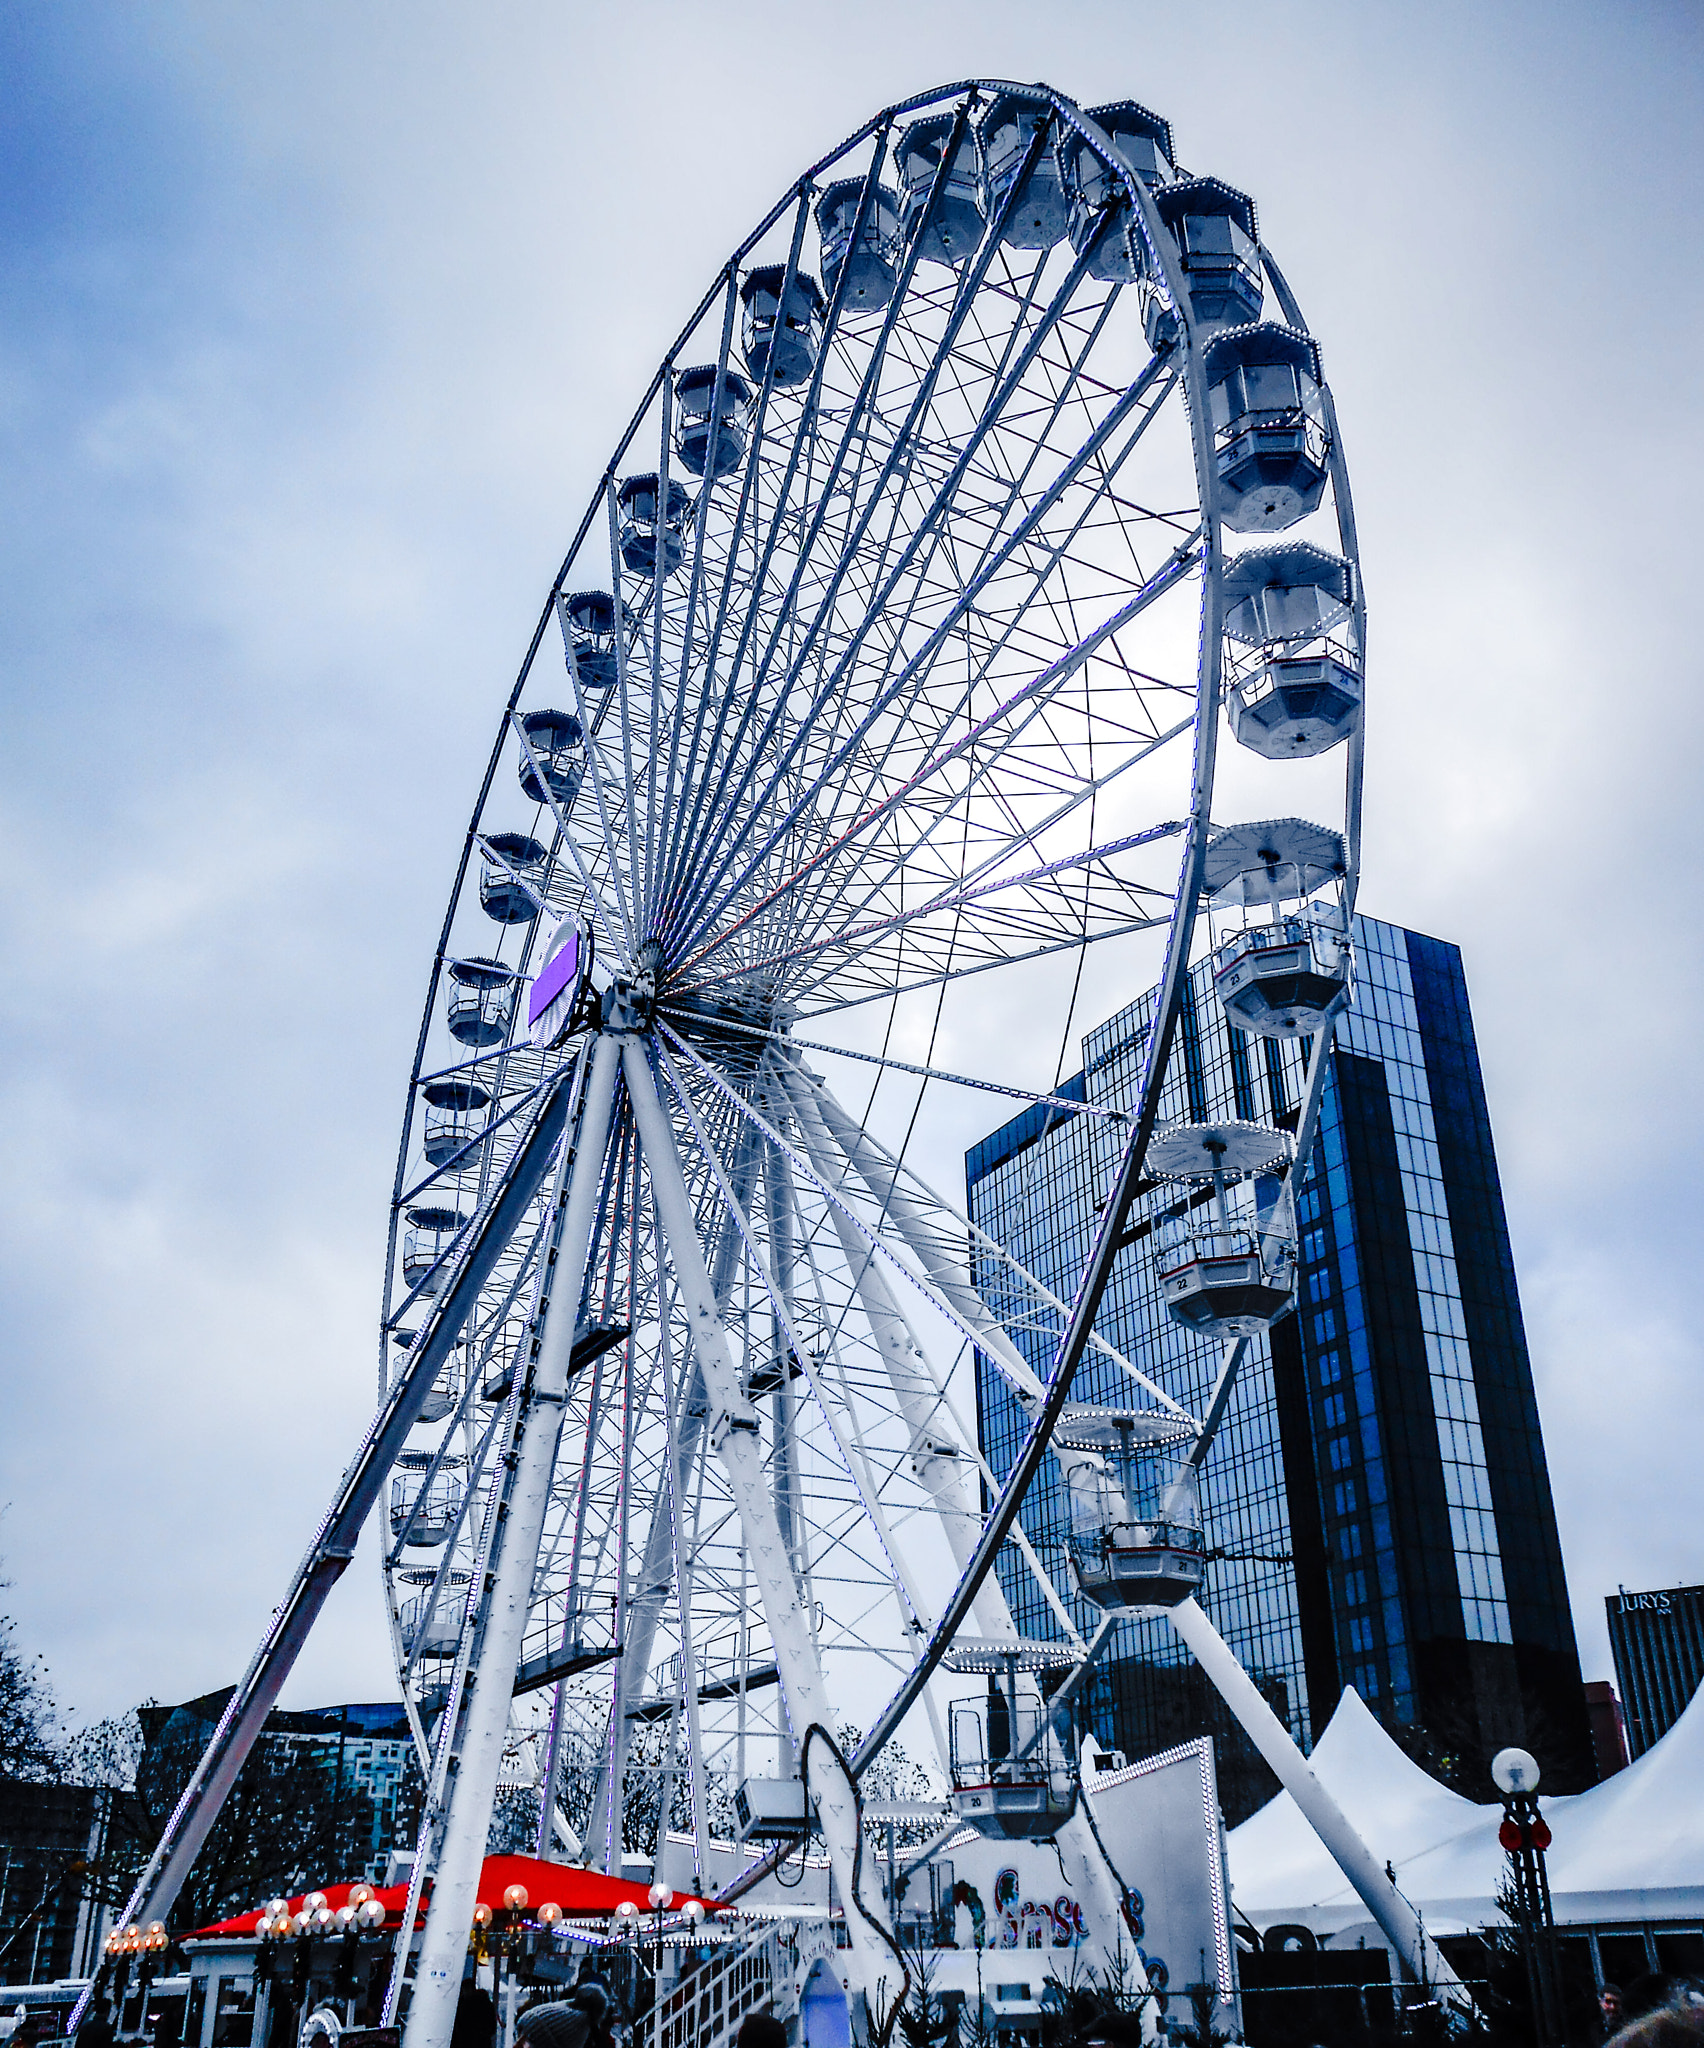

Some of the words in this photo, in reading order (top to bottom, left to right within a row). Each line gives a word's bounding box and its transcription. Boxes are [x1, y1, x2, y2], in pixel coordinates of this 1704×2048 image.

[1230, 973, 1240, 986] 23
[1177, 1278, 1188, 1291] 22
[1178, 1560, 1187, 1572] 21
[1616, 1590, 1670, 1614] JURYS
[971, 1796, 982, 1807] 20
